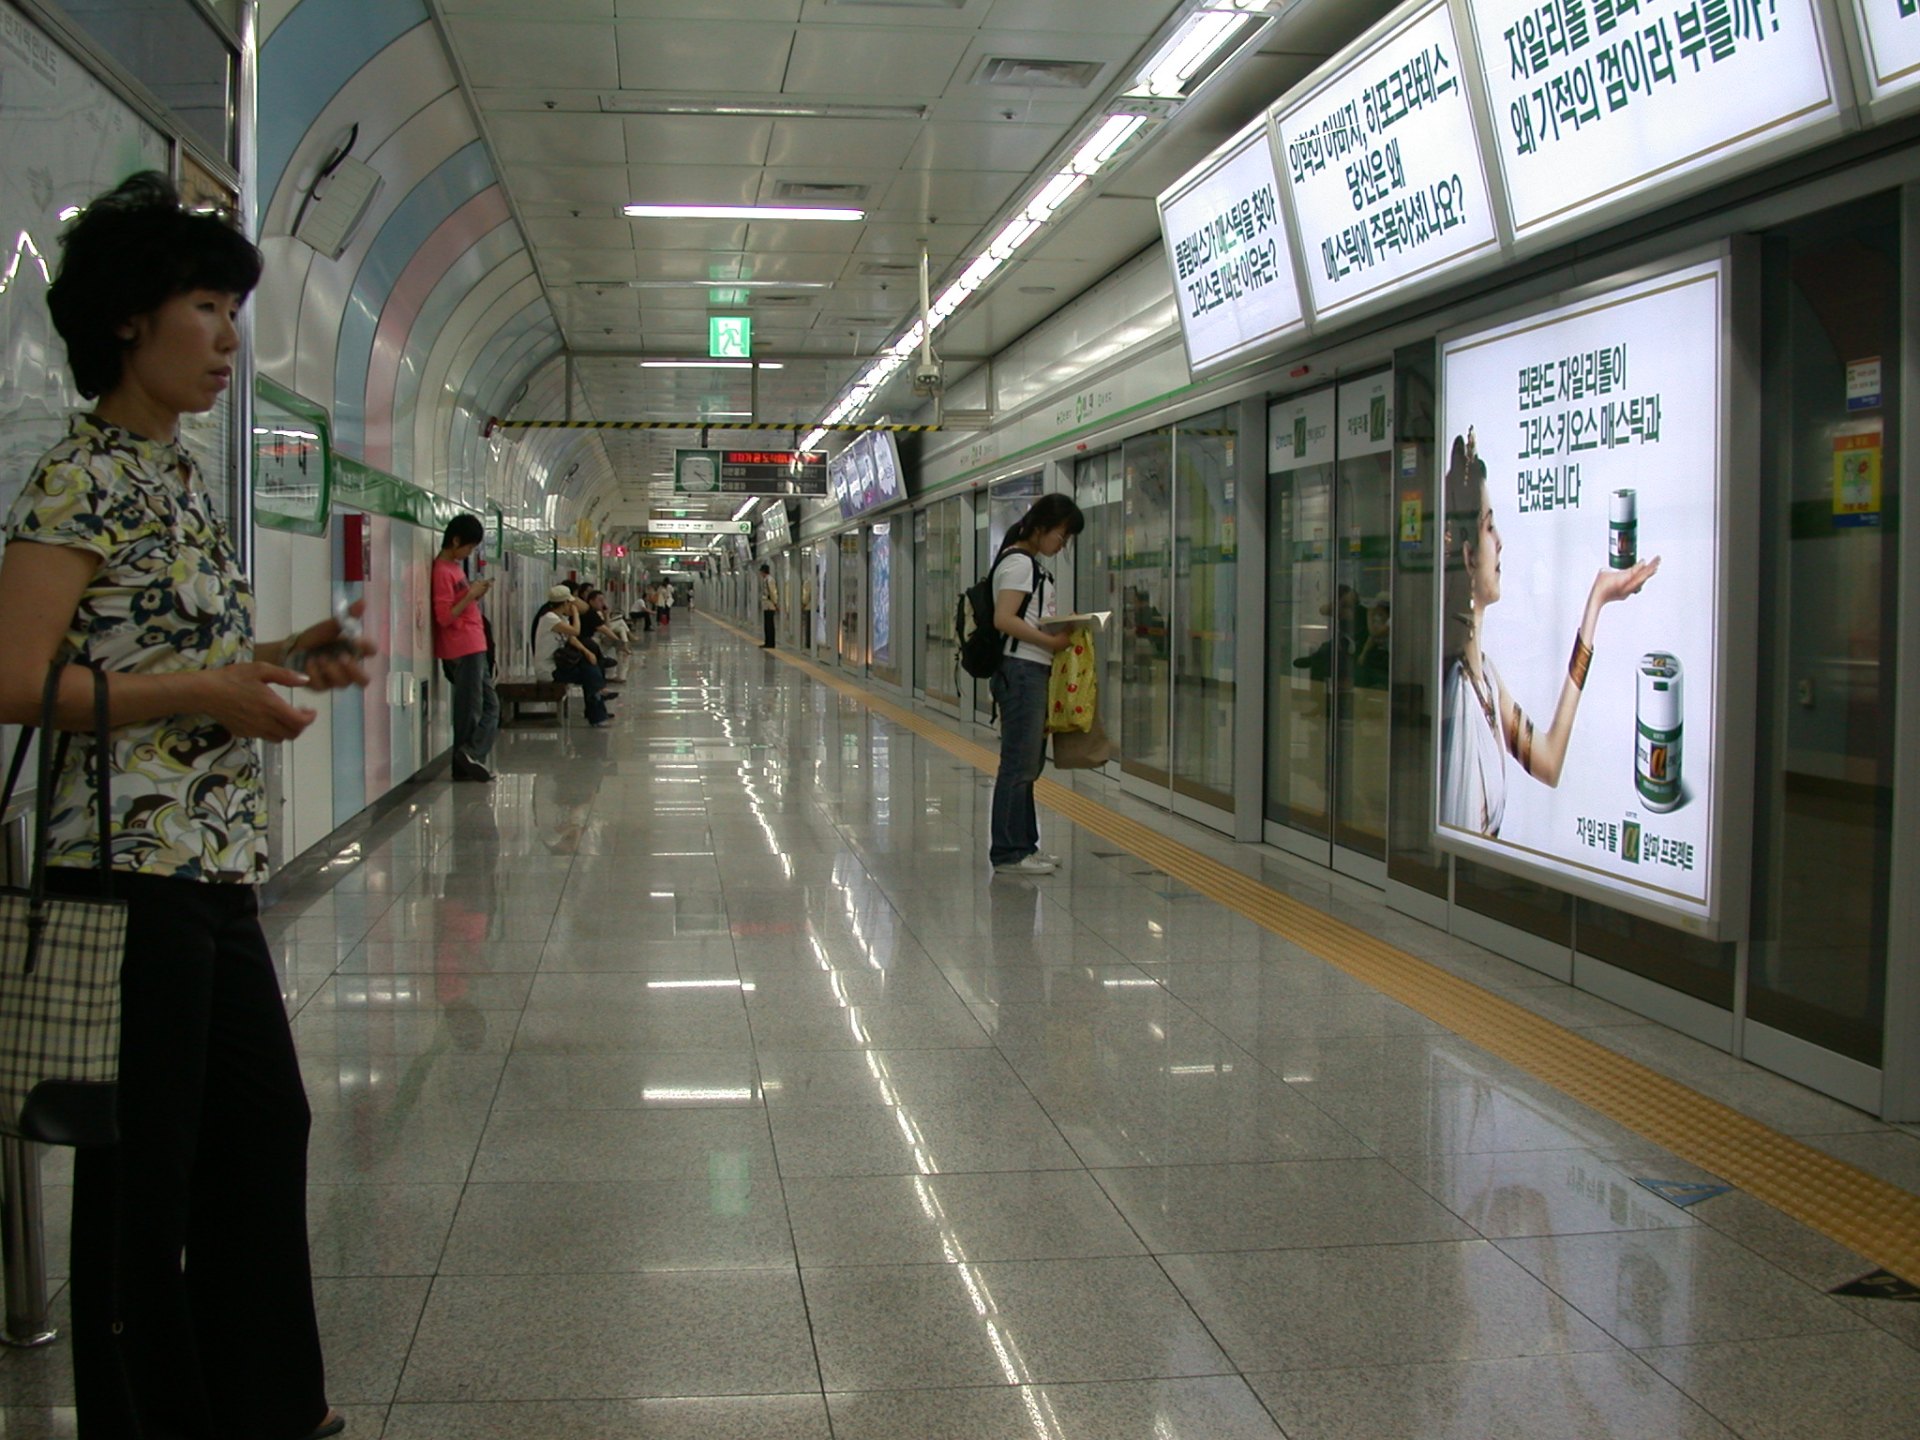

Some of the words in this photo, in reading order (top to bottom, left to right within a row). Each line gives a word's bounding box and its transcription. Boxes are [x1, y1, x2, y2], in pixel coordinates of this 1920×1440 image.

[1288, 129, 1326, 184] 의학의
[1362, 43, 1459, 135] 히포크라테스,
[1510, 91, 1536, 156] 왜
[1532, 58, 1602, 142] 기적의
[1596, 18, 1676, 113] 껌이라
[1345, 149, 1389, 211] 당신은
[1385, 137, 1406, 188] 왜
[1175, 222, 1218, 280] 콜럼버스가
[1252, 183, 1277, 234] 찾아
[1321, 219, 1374, 283] 매스틱에
[1369, 173, 1466, 261] 주목하셨나요?
[1188, 270, 1224, 318] 그리스로
[1220, 257, 1242, 301] 떠난
[1240, 238, 1279, 291] 이유는?
[1518, 362, 1555, 411] 핀란드
[1558, 343, 1626, 401] 자일리톨이
[1518, 415, 1555, 460] 그리스
[1557, 407, 1598, 455] 키오스
[1600, 393, 1661, 449] 매스틱과
[1518, 463, 1581, 513] 만났습니다
[1576, 816, 1618, 853] 자일리톨
